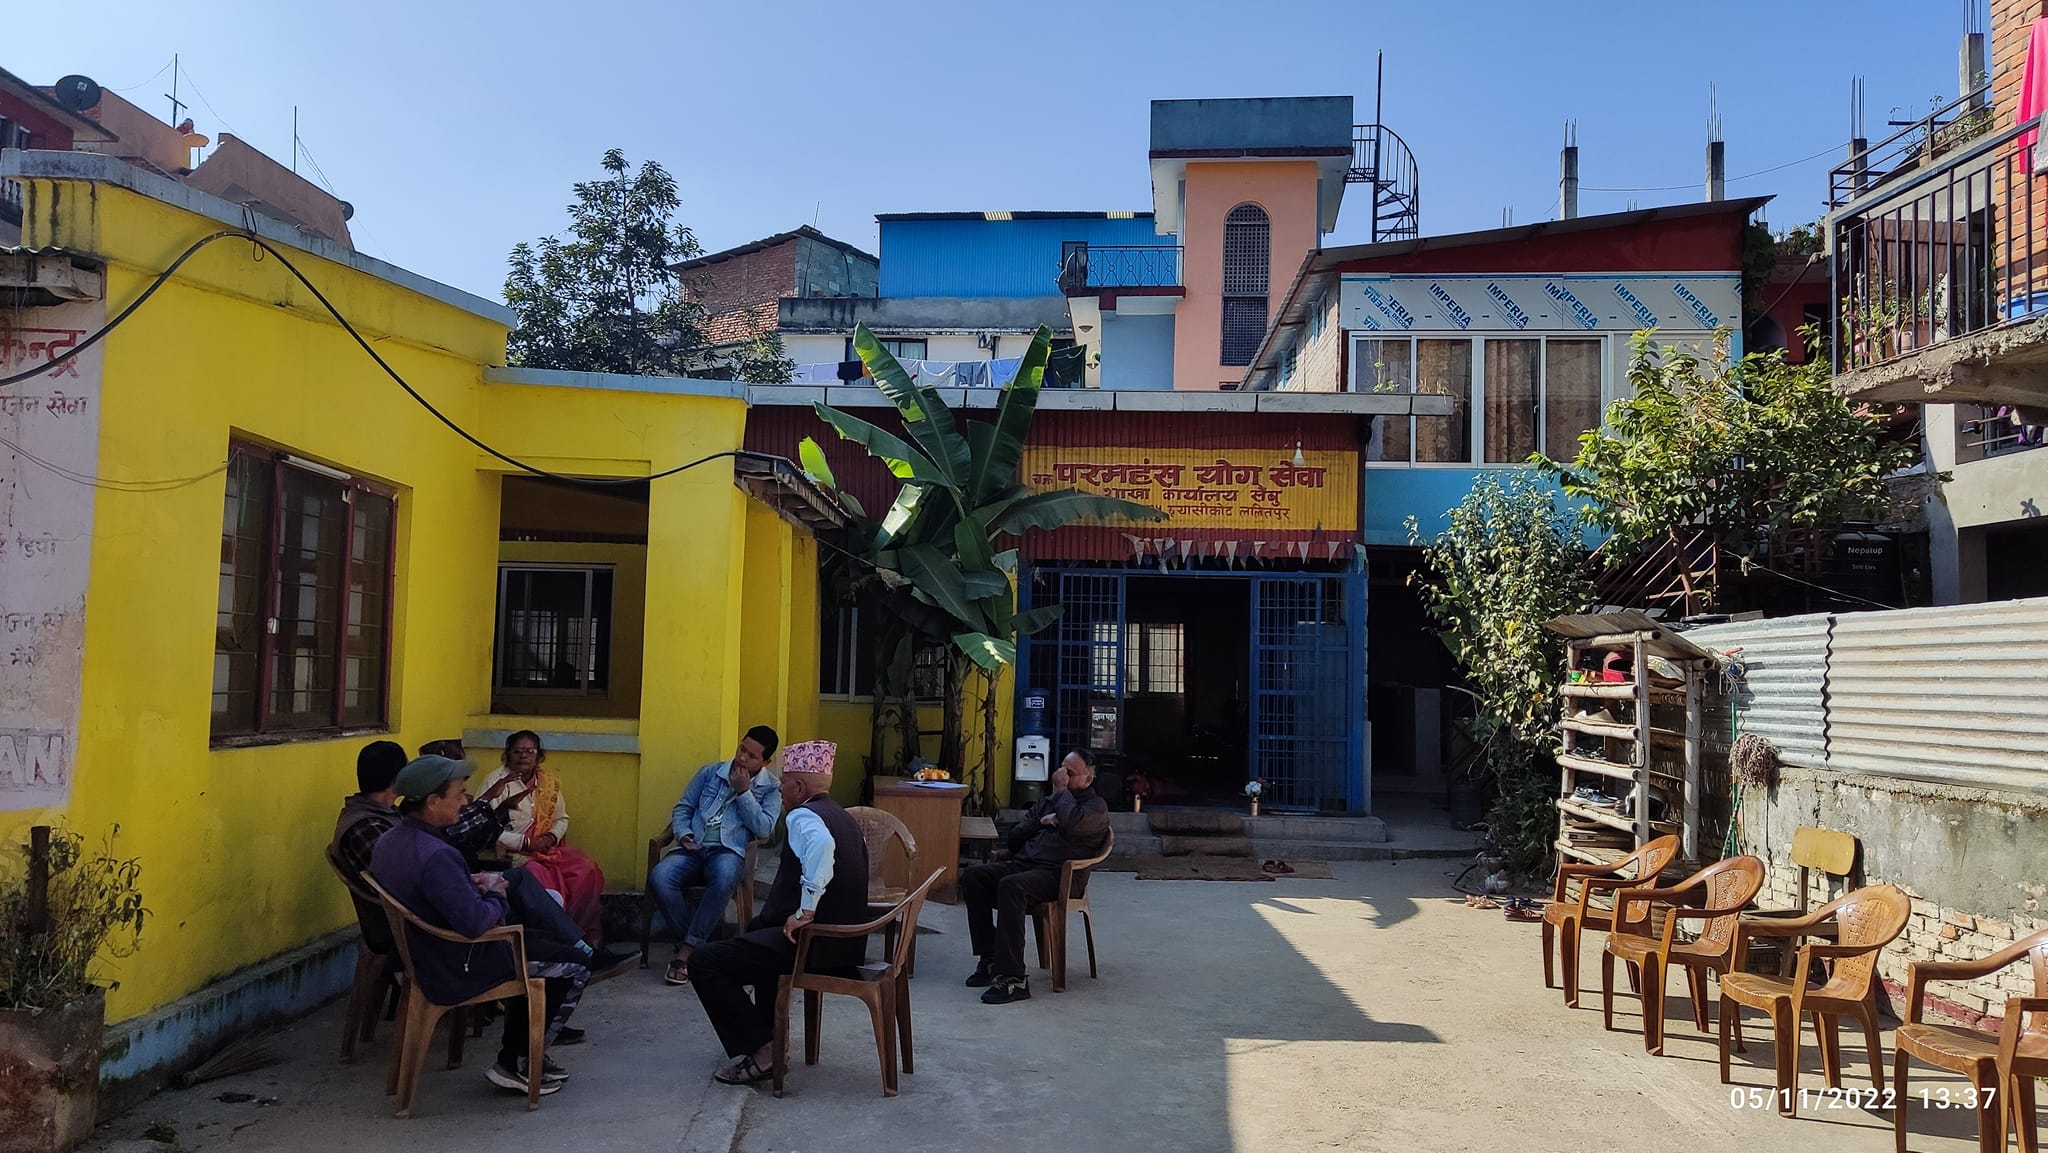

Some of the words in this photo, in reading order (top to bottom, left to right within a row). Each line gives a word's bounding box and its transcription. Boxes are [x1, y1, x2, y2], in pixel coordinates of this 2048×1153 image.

[1429, 282, 1472, 326] IMPERIA
[1487, 282, 1529, 326] IMPERIA
[1614, 283, 1658, 327] IMPERIA
[1673, 283, 1718, 327] IMPERIA
[1053, 457, 1185, 488] परमहंस
[1193, 459, 1263, 486] योग
[1269, 459, 1327, 488] सेवा
[1162, 485, 1239, 502] कार्यालय
